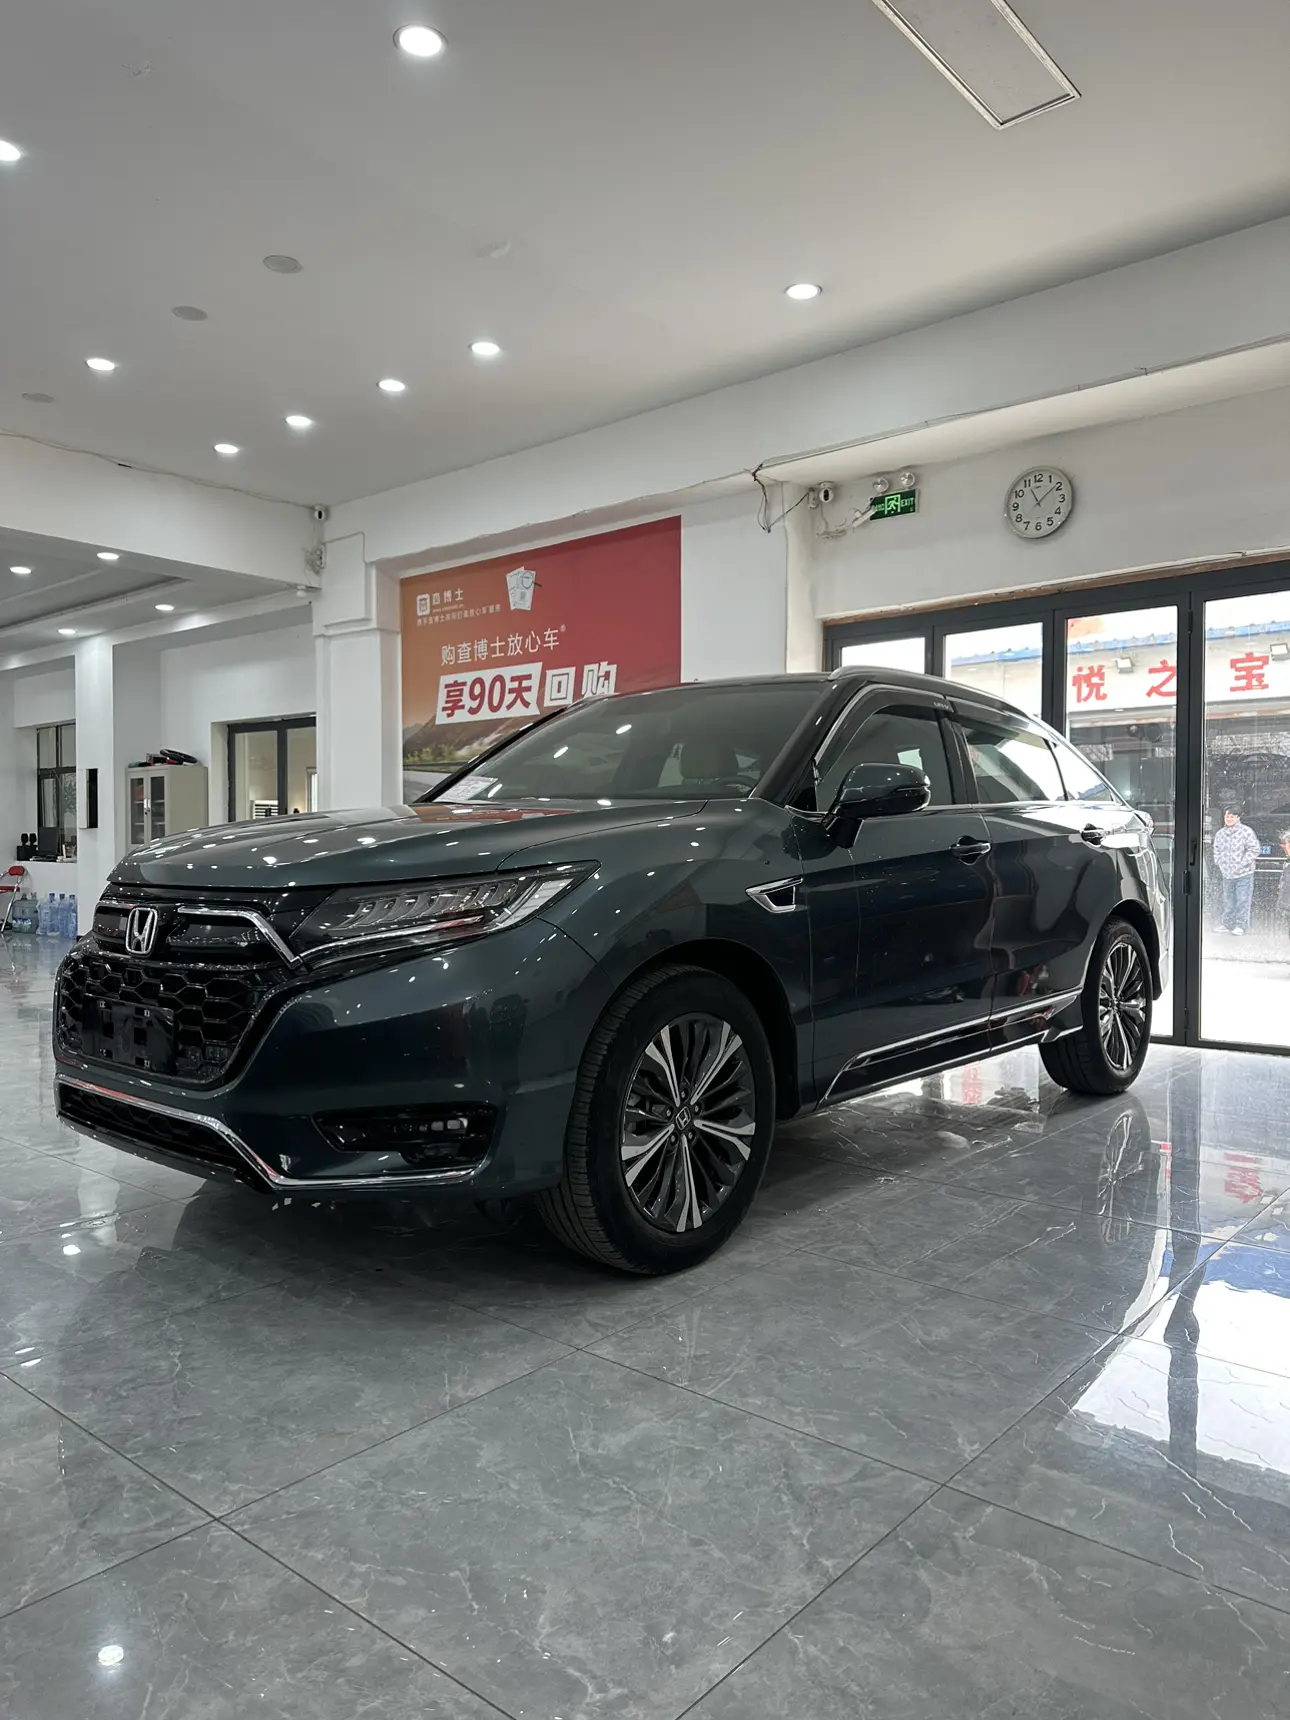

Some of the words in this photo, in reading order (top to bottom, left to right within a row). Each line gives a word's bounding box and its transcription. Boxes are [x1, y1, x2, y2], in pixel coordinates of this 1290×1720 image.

[1034, 473, 1044, 483] 12
[1023, 479, 1031, 488] 11
[1056, 481, 1063, 491] 2
[1014, 489, 1025, 498] 10
[1058, 493, 1066, 503] 3
[900, 497, 914, 507] EXIT
[1012, 502, 1019, 511] 9
[1054, 506, 1061, 515] 4
[1015, 513, 1023, 523] 8
[1046, 516, 1054, 526] 5
[1023, 521, 1031, 530] 7
[1035, 521, 1042, 531] 6
